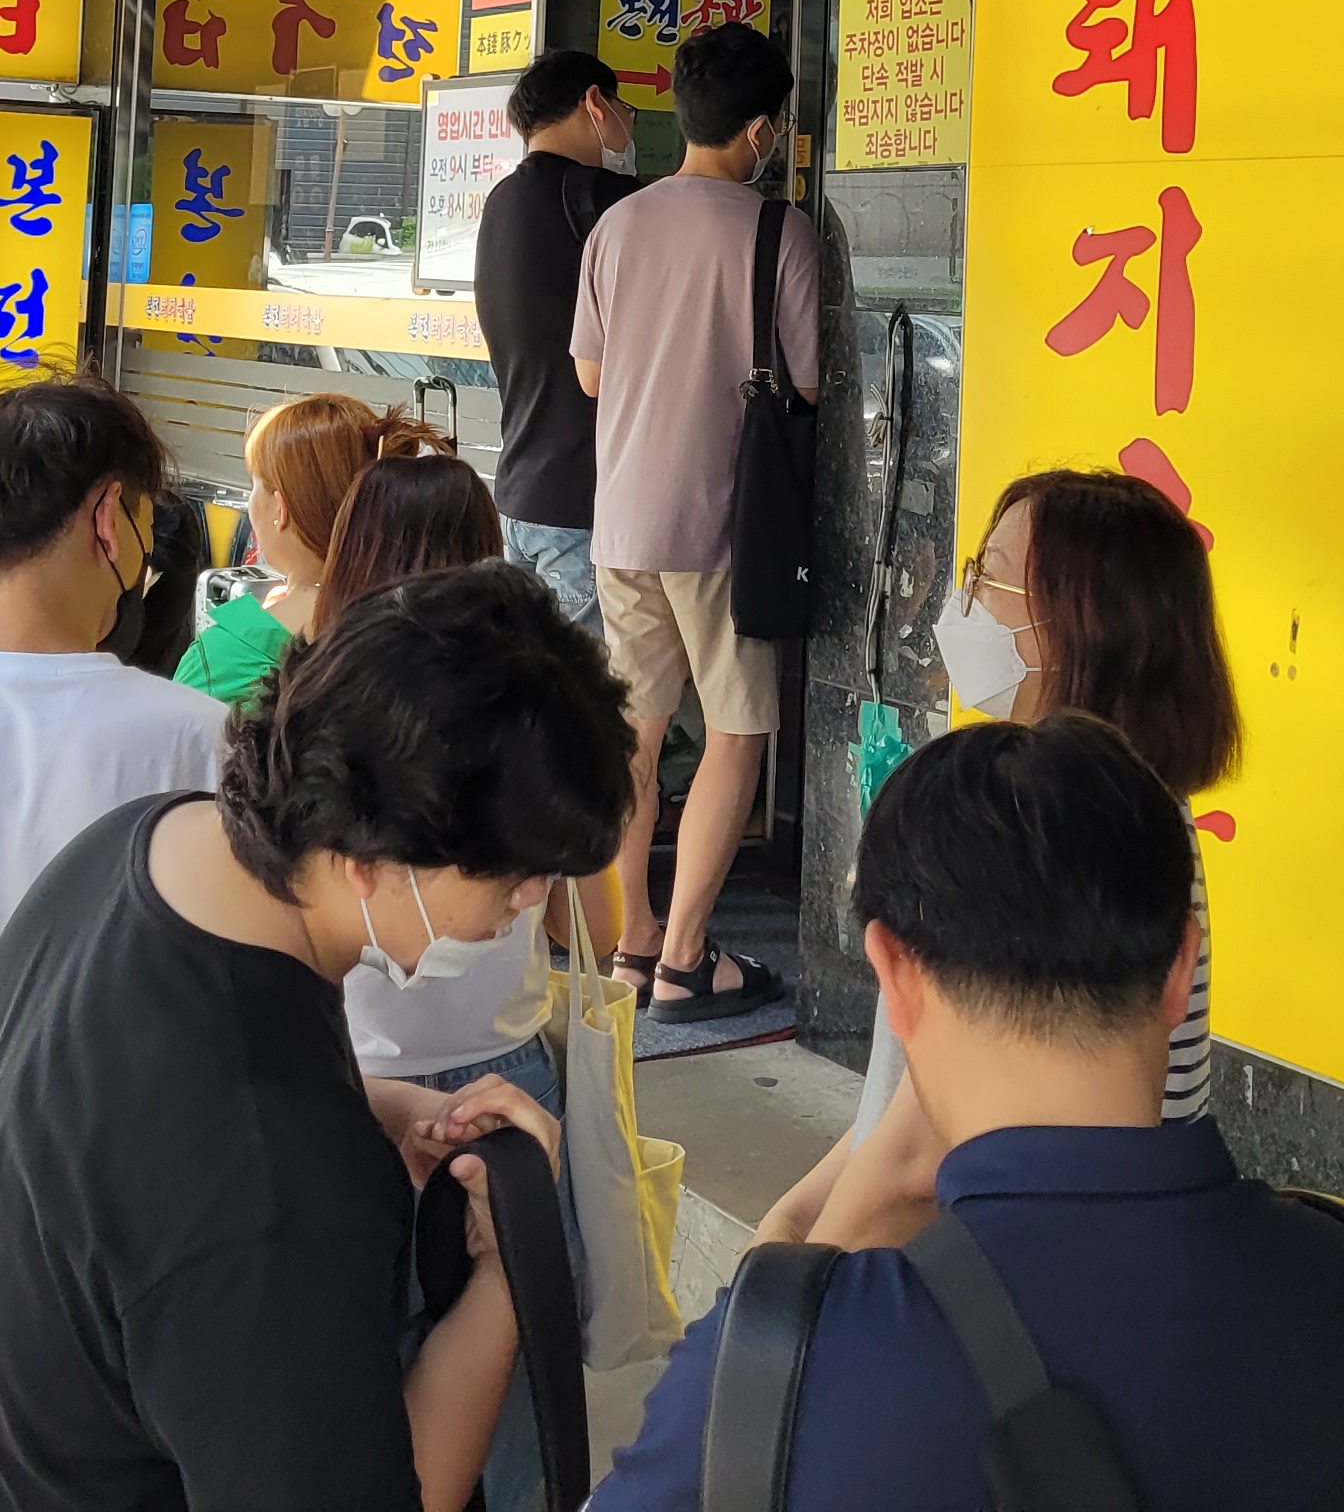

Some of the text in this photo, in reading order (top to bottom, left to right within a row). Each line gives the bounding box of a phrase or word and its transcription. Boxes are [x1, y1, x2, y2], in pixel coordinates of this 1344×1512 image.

[844, 18, 965, 61] 주차장이 없습니다
[861, 55, 944, 92] 단속 적발 시
[843, 88, 964, 128] 책임지지 않습니다
[437, 109, 511, 141] 영업시간 안내
[865, 126, 937, 159] 죄송합니다
[430, 153, 494, 183] 오전 9시 부터
[447, 192, 465, 220] 8시
